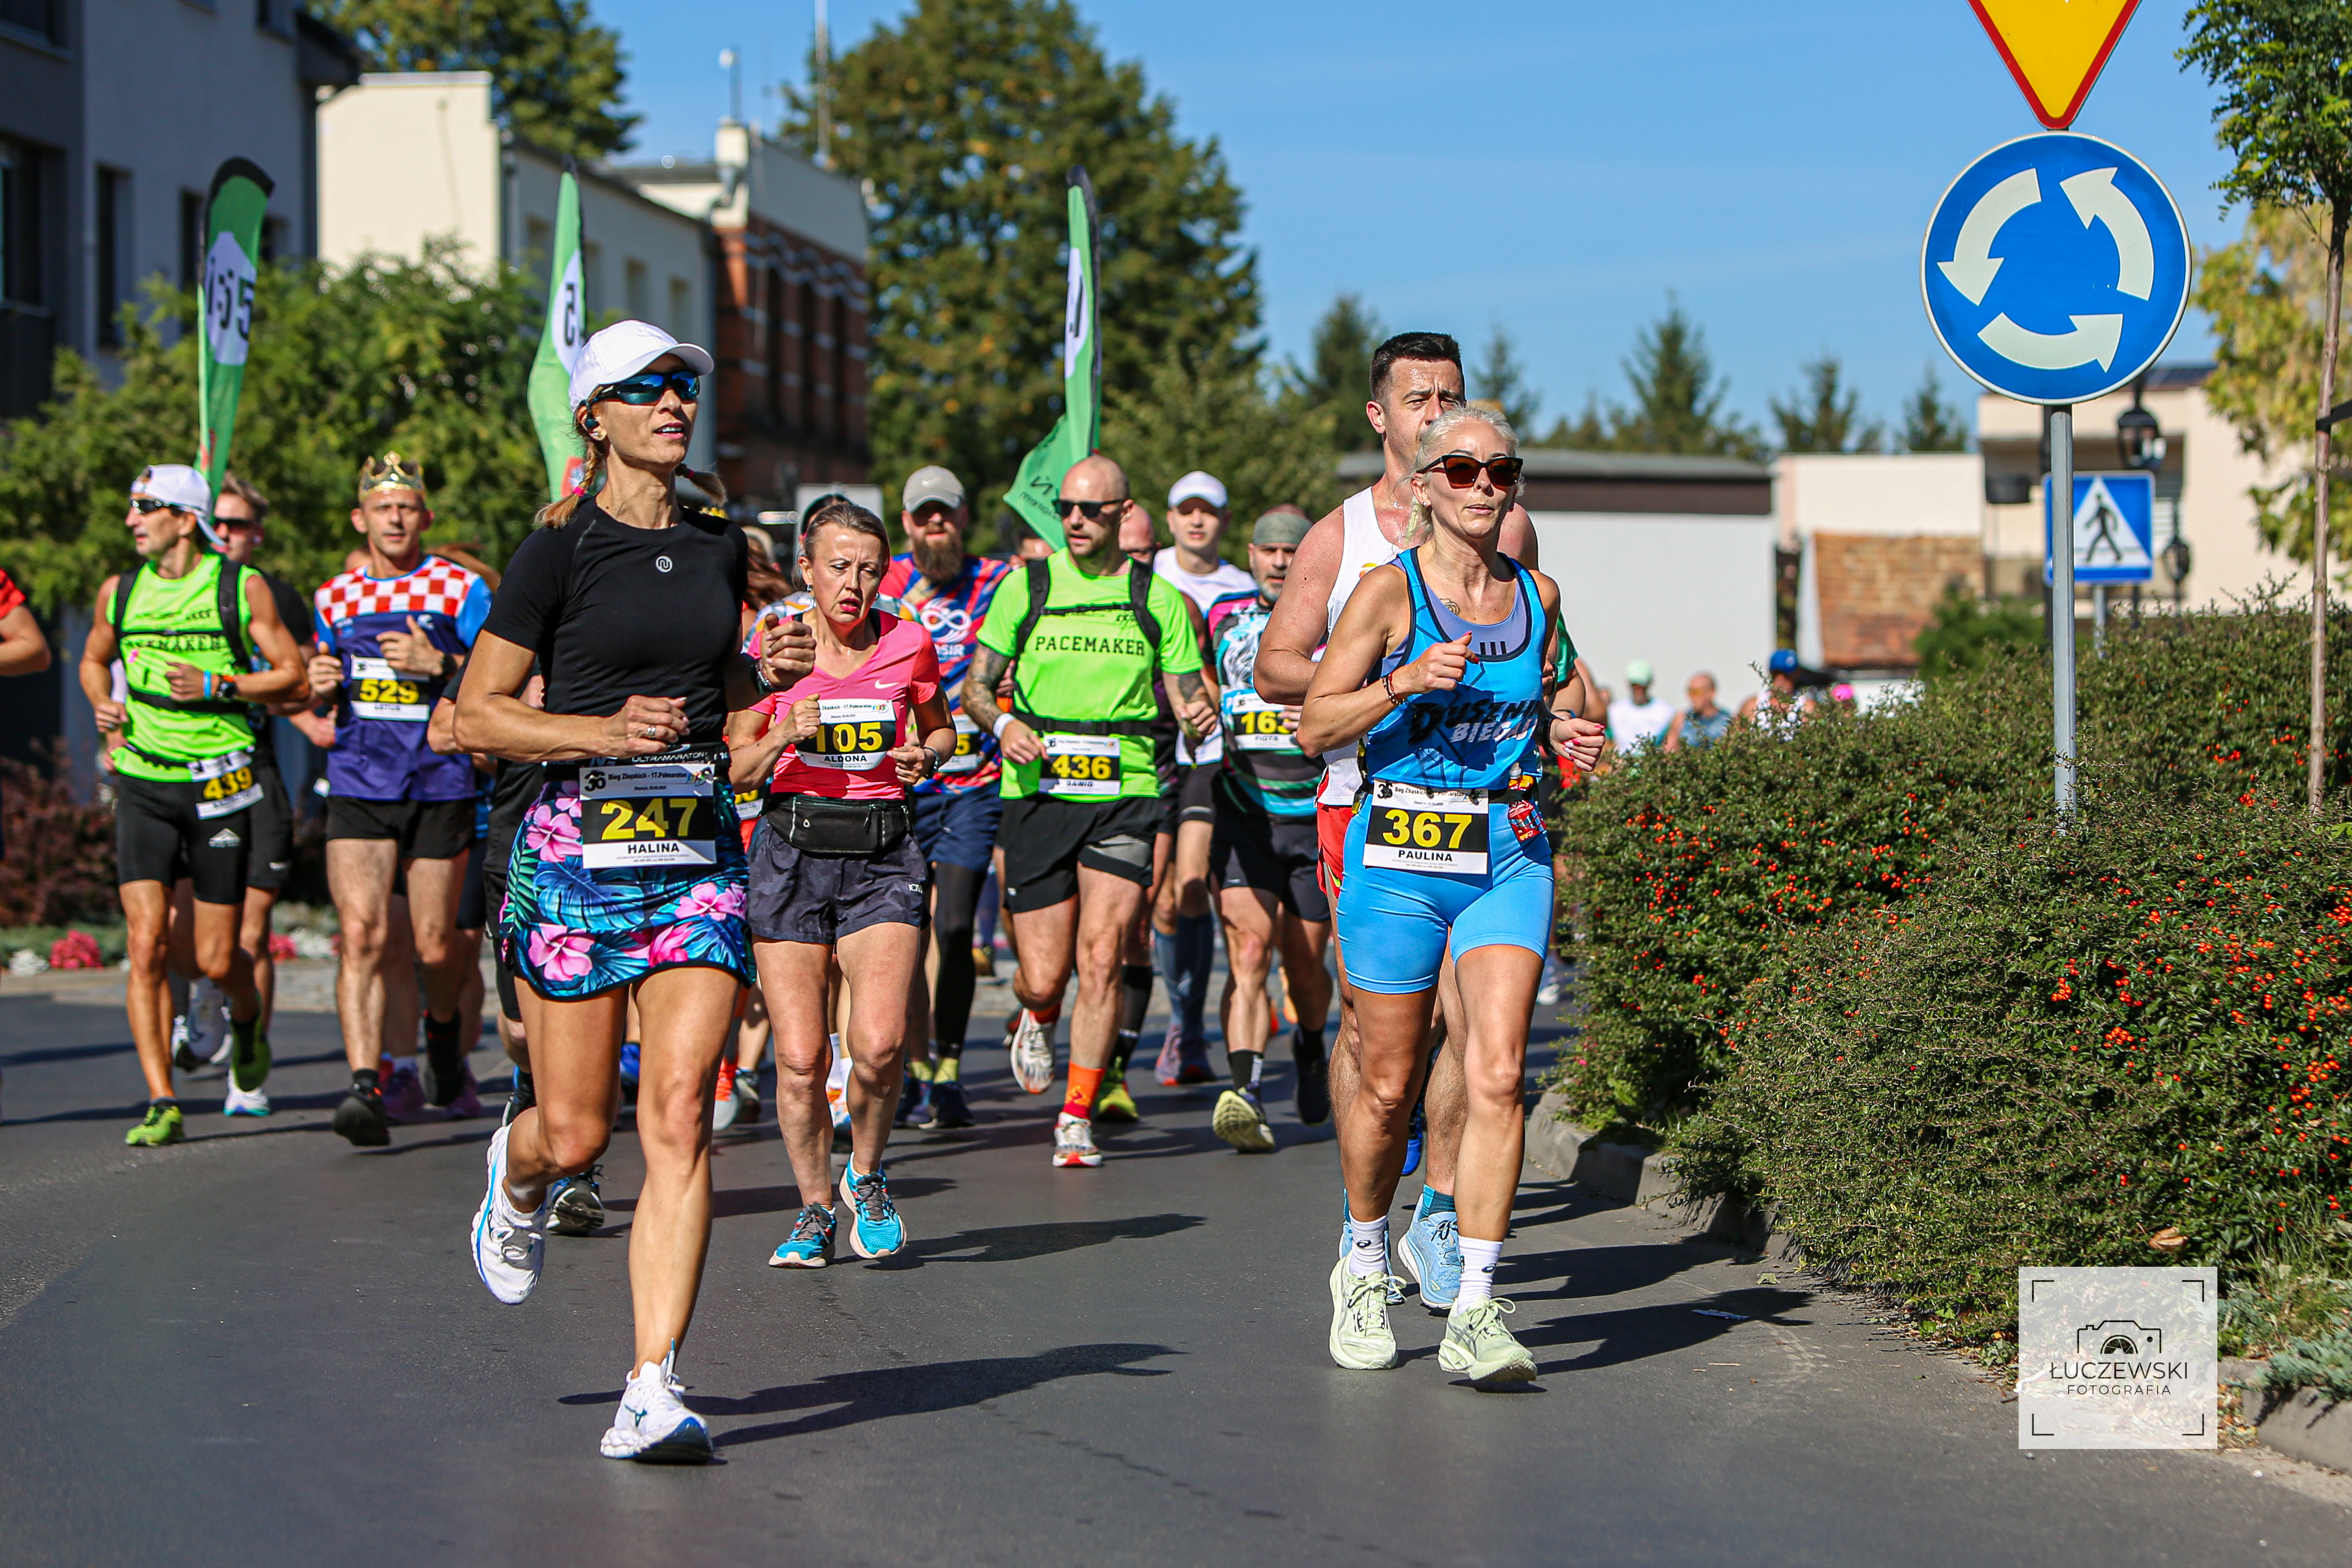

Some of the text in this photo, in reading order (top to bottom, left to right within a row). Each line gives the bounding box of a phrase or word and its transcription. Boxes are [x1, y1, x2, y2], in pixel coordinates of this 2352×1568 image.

[1036, 636, 1144, 656] PACEMAKER
[359, 678, 419, 704] 529
[808, 722, 883, 753] 105
[954, 733, 970, 755] 5
[1051, 754, 1112, 779] 436
[203, 766, 253, 800] 439
[601, 798, 697, 841] 247
[1382, 809, 1472, 849] 367
[627, 843, 680, 854] HALINA
[1398, 850, 1453, 862] PAULINA
